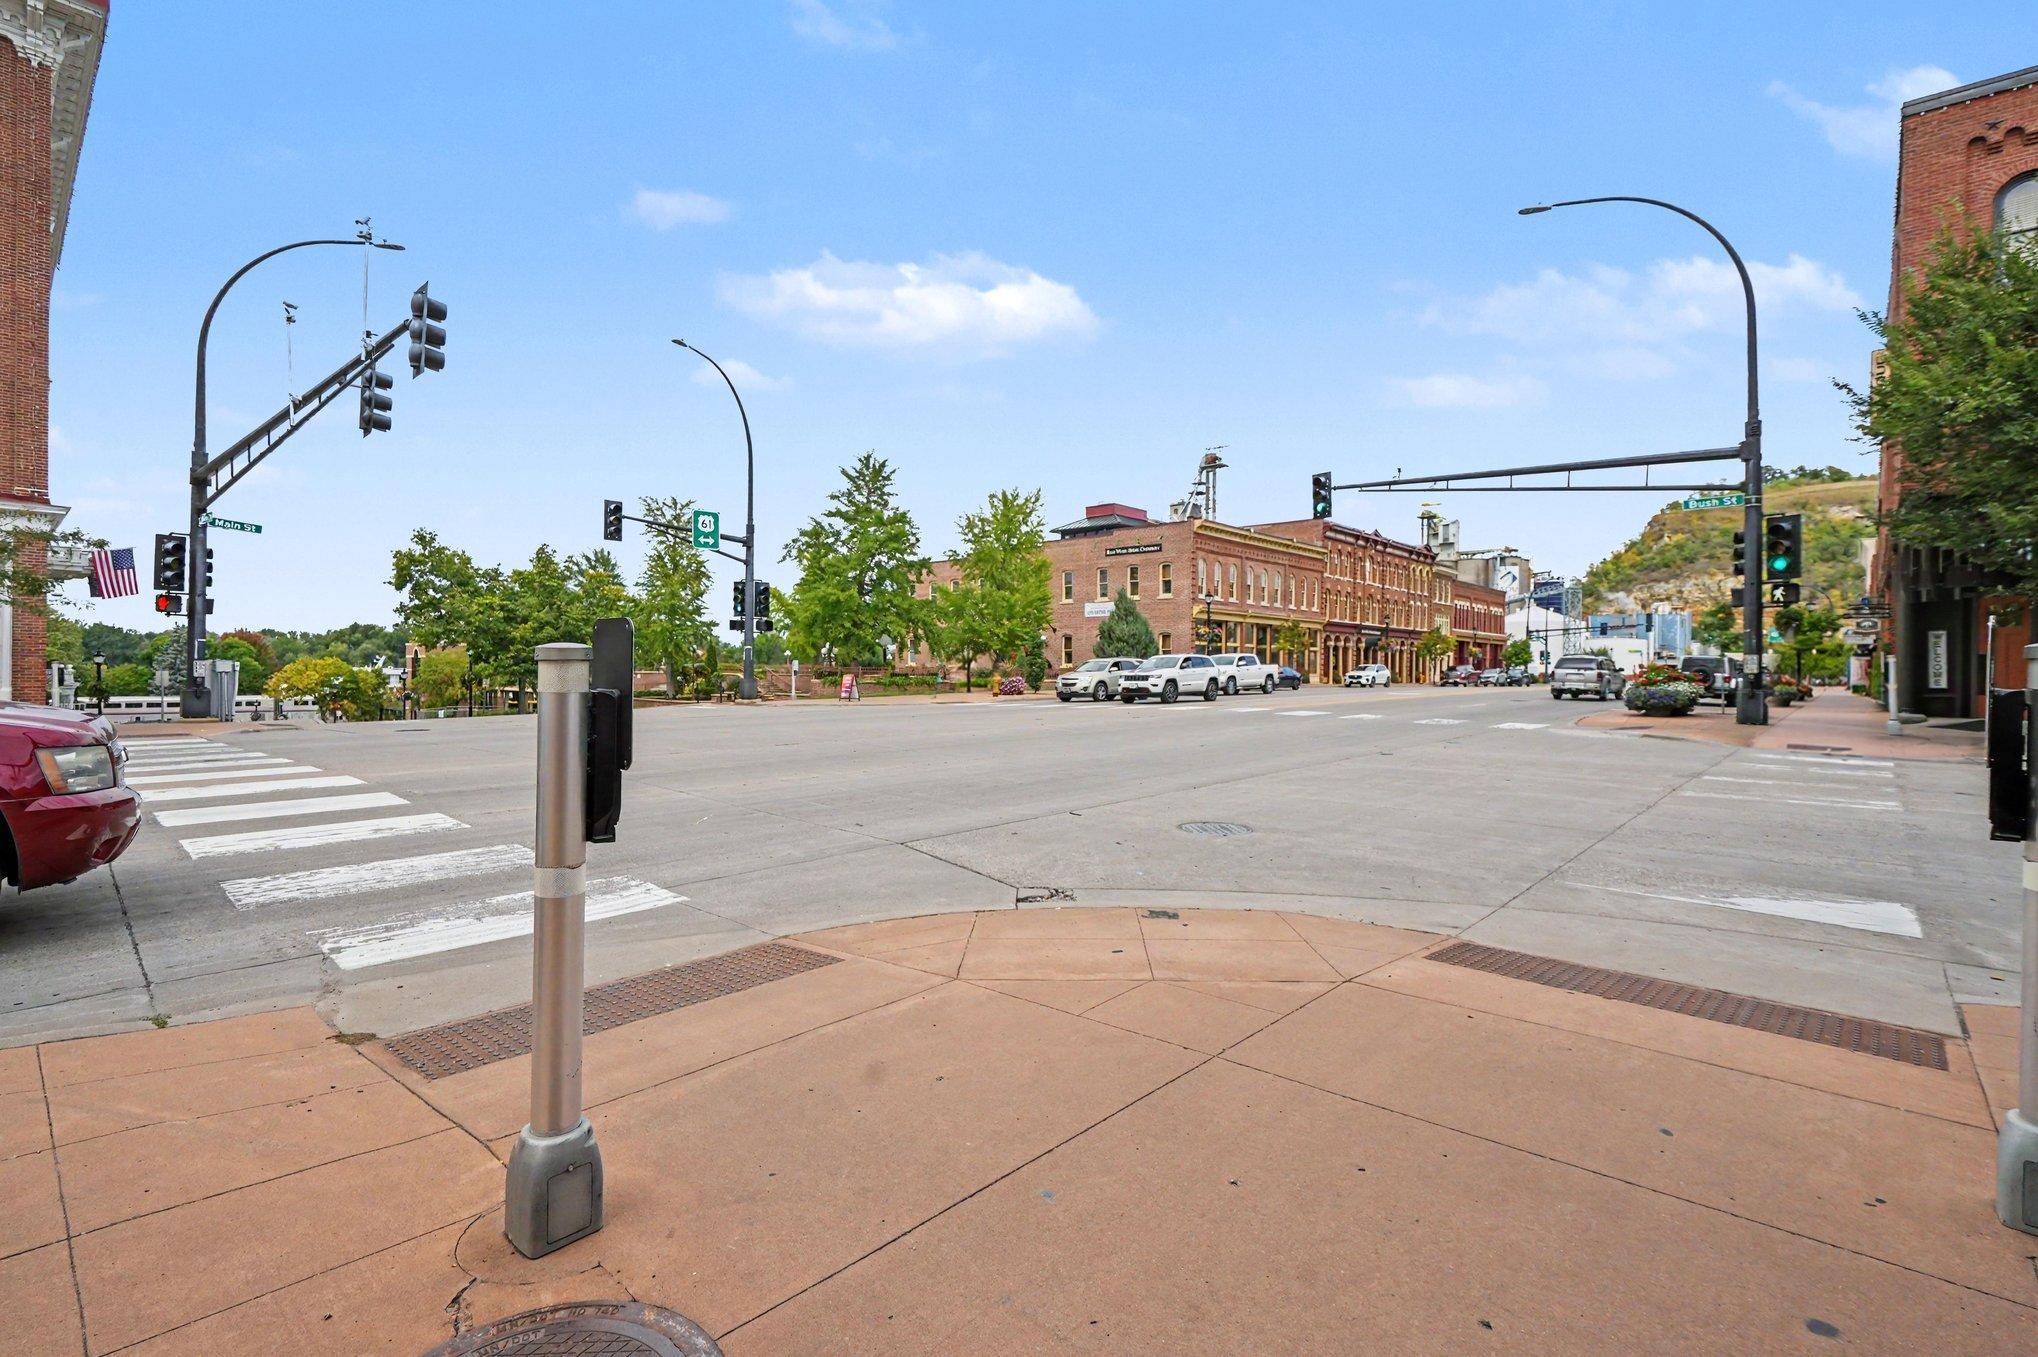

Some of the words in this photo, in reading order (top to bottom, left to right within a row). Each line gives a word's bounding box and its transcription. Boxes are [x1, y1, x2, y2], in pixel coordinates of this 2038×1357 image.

[1688, 499, 1719, 509] Bush
[1722, 496, 1738, 506] St
[215, 518, 241, 530] Main
[243, 523, 257, 533] St
[701, 519, 712, 529] 61
[1932, 632, 1944, 687] WELCOME
